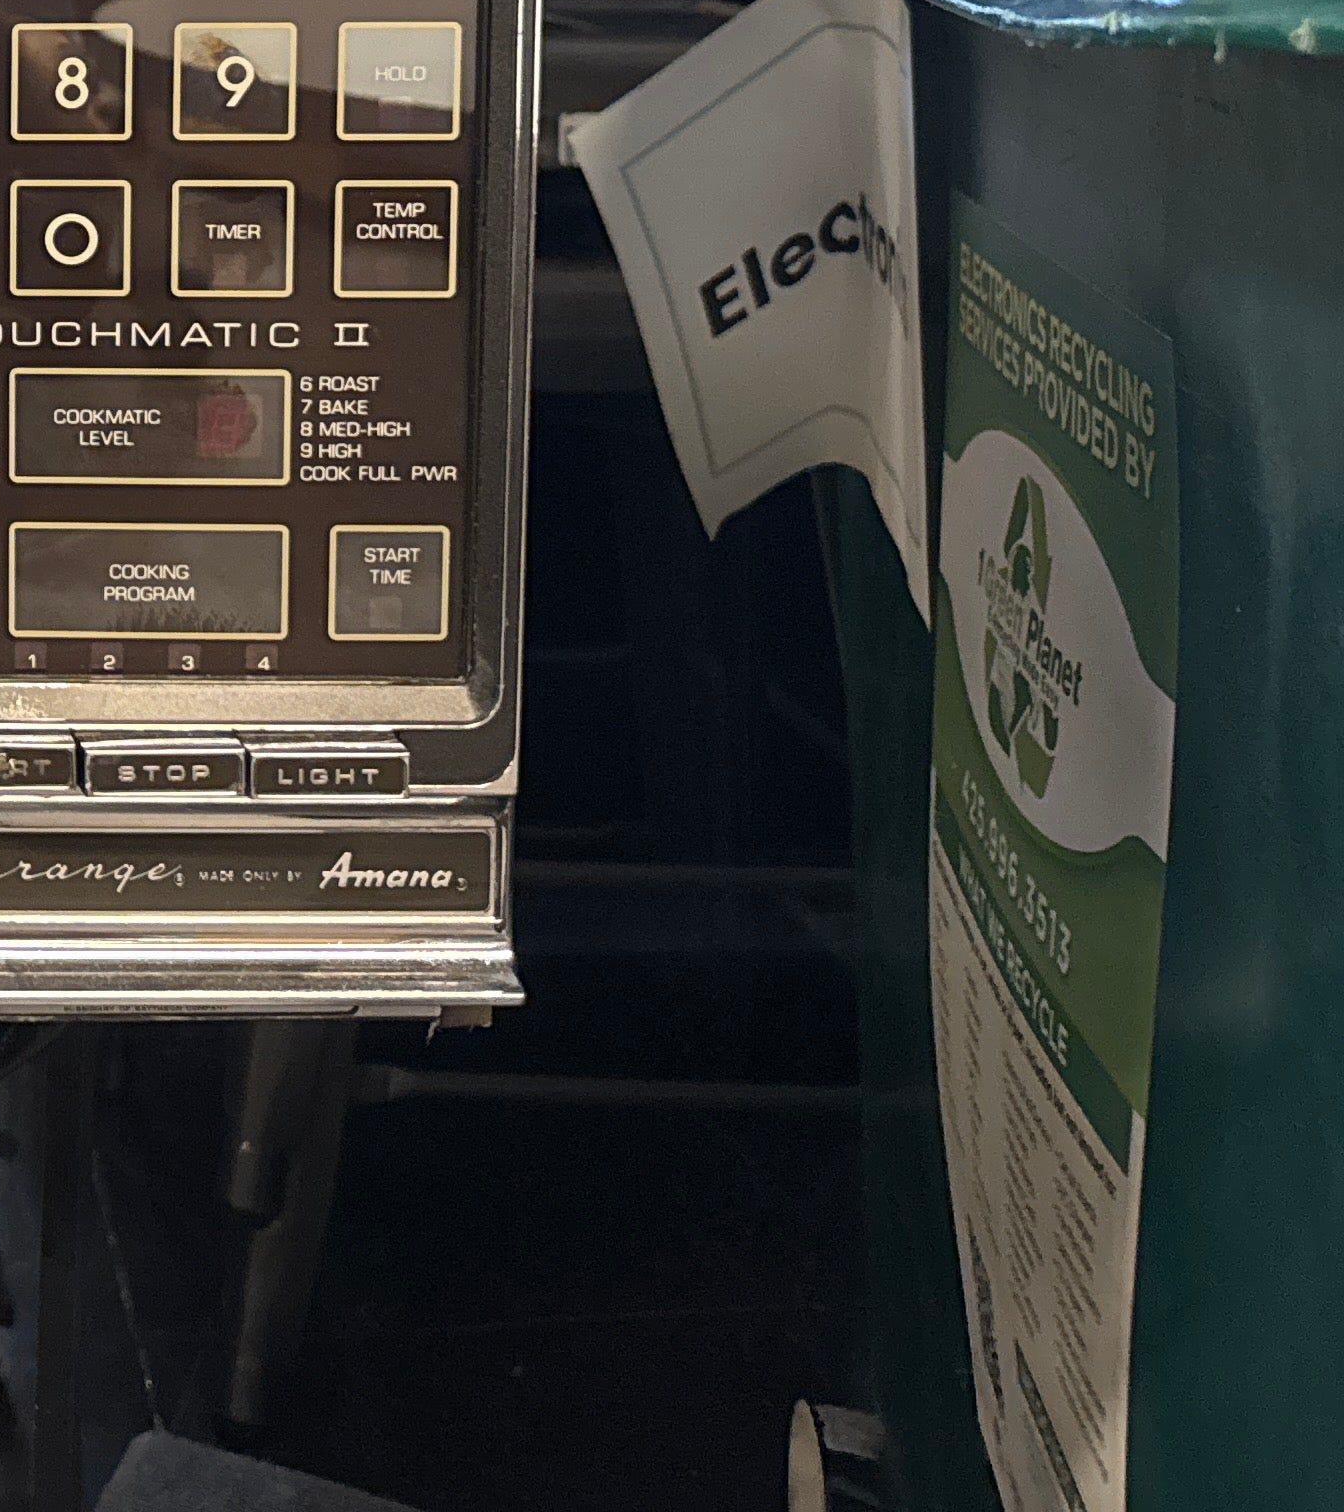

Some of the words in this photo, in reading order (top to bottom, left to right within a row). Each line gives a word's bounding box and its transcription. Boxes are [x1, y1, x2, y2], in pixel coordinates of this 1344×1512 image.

[216, 55, 256, 108] 9
[374, 65, 428, 82] HOLD
[54, 56, 90, 109] 8
[372, 202, 426, 219] TEMP
[205, 224, 261, 240] TIMER
[356, 223, 443, 240] CONTROL
[960, 241, 1046, 354] ELECTRONICS
[1049, 313, 1155, 437] RECYCLING
[299, 375, 313, 393] 6
[318, 375, 380, 392] ROAST
[960, 291, 1020, 387] SERVICES
[1023, 350, 1119, 470] PROVIDED
[1124, 430, 1156, 500] BY
[301, 398, 313, 414] 7
[318, 399, 368, 415] BAKE
[53, 408, 161, 425] COOKMATIC
[300, 421, 313, 437] 8
[319, 421, 411, 437] MED-HIGH
[79, 430, 135, 446] LEVEL
[300, 442, 313, 459] 9
[318, 442, 362, 459] HIGH
[299, 465, 352, 482] COOK
[358, 465, 401, 482] FULL
[411, 465, 457, 481] PWR
[364, 547, 421, 563] START
[109, 563, 190, 580] COOKING
[369, 569, 412, 585] TIME
[103, 585, 195, 602] PROGRAM
[28, 654, 36, 669] 1
[103, 654, 116, 670] 2
[181, 655, 195, 671] 3
[257, 656, 270, 671] 4
[1026, 606, 1082, 707] Planet
[118, 764, 210, 782] STOP
[278, 768, 379, 785] LIGHT
[198, 869, 235, 883] MADE
[242, 869, 280, 883] ONLY
[318, 850, 454, 890] Amana
[1005, 938, 1069, 1068] RECYCLE
